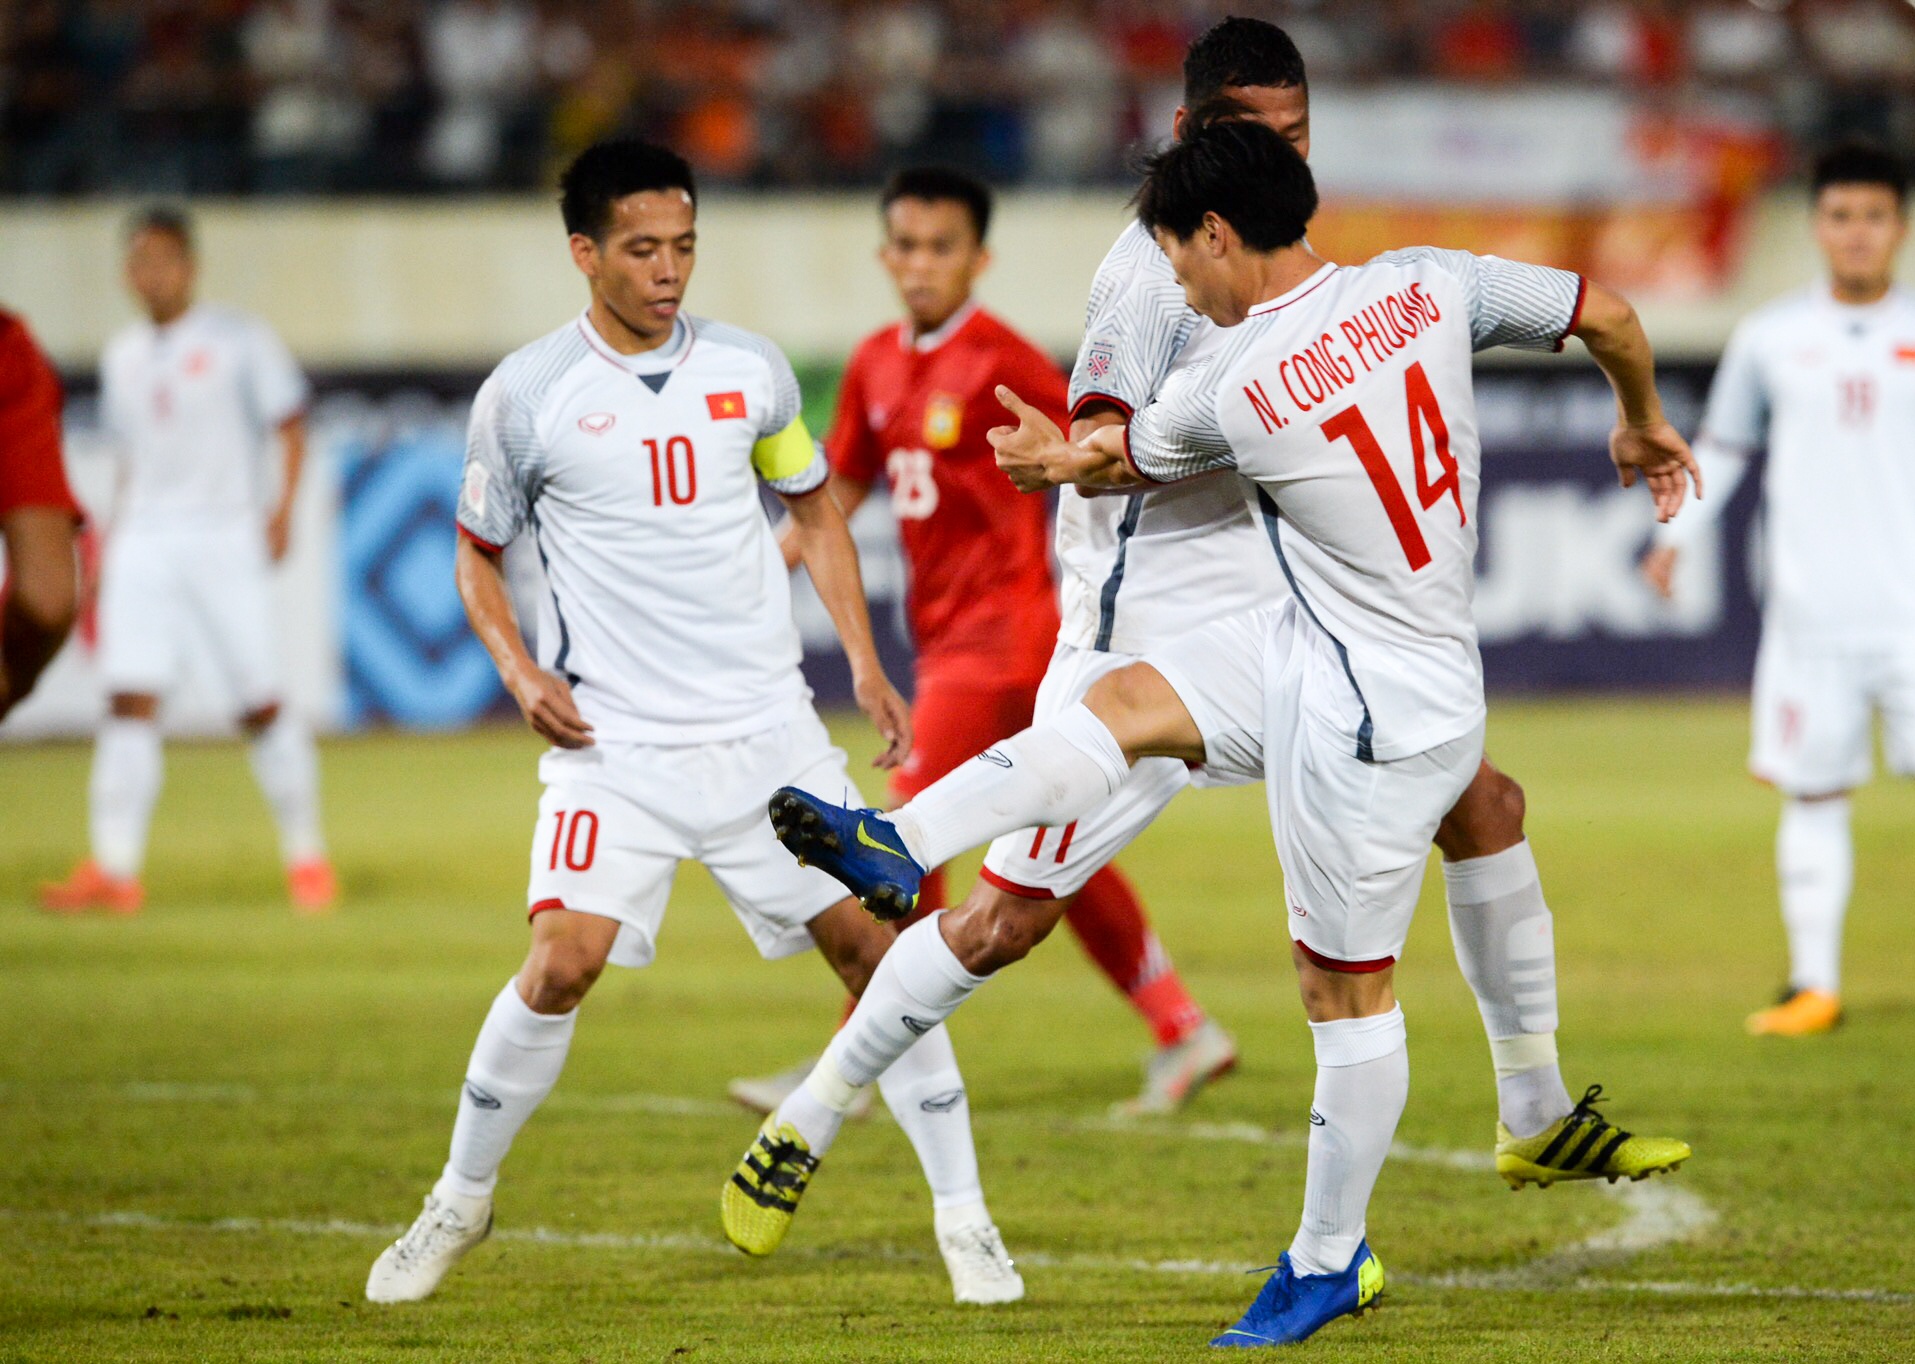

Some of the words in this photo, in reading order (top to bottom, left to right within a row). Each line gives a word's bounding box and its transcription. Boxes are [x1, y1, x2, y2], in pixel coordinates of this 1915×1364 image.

[1243, 379, 1290, 435] N.
[1279, 333, 1355, 412] CONG
[641, 435, 697, 507] 10
[1319, 360, 1467, 572] 14
[549, 809, 599, 872] 10
